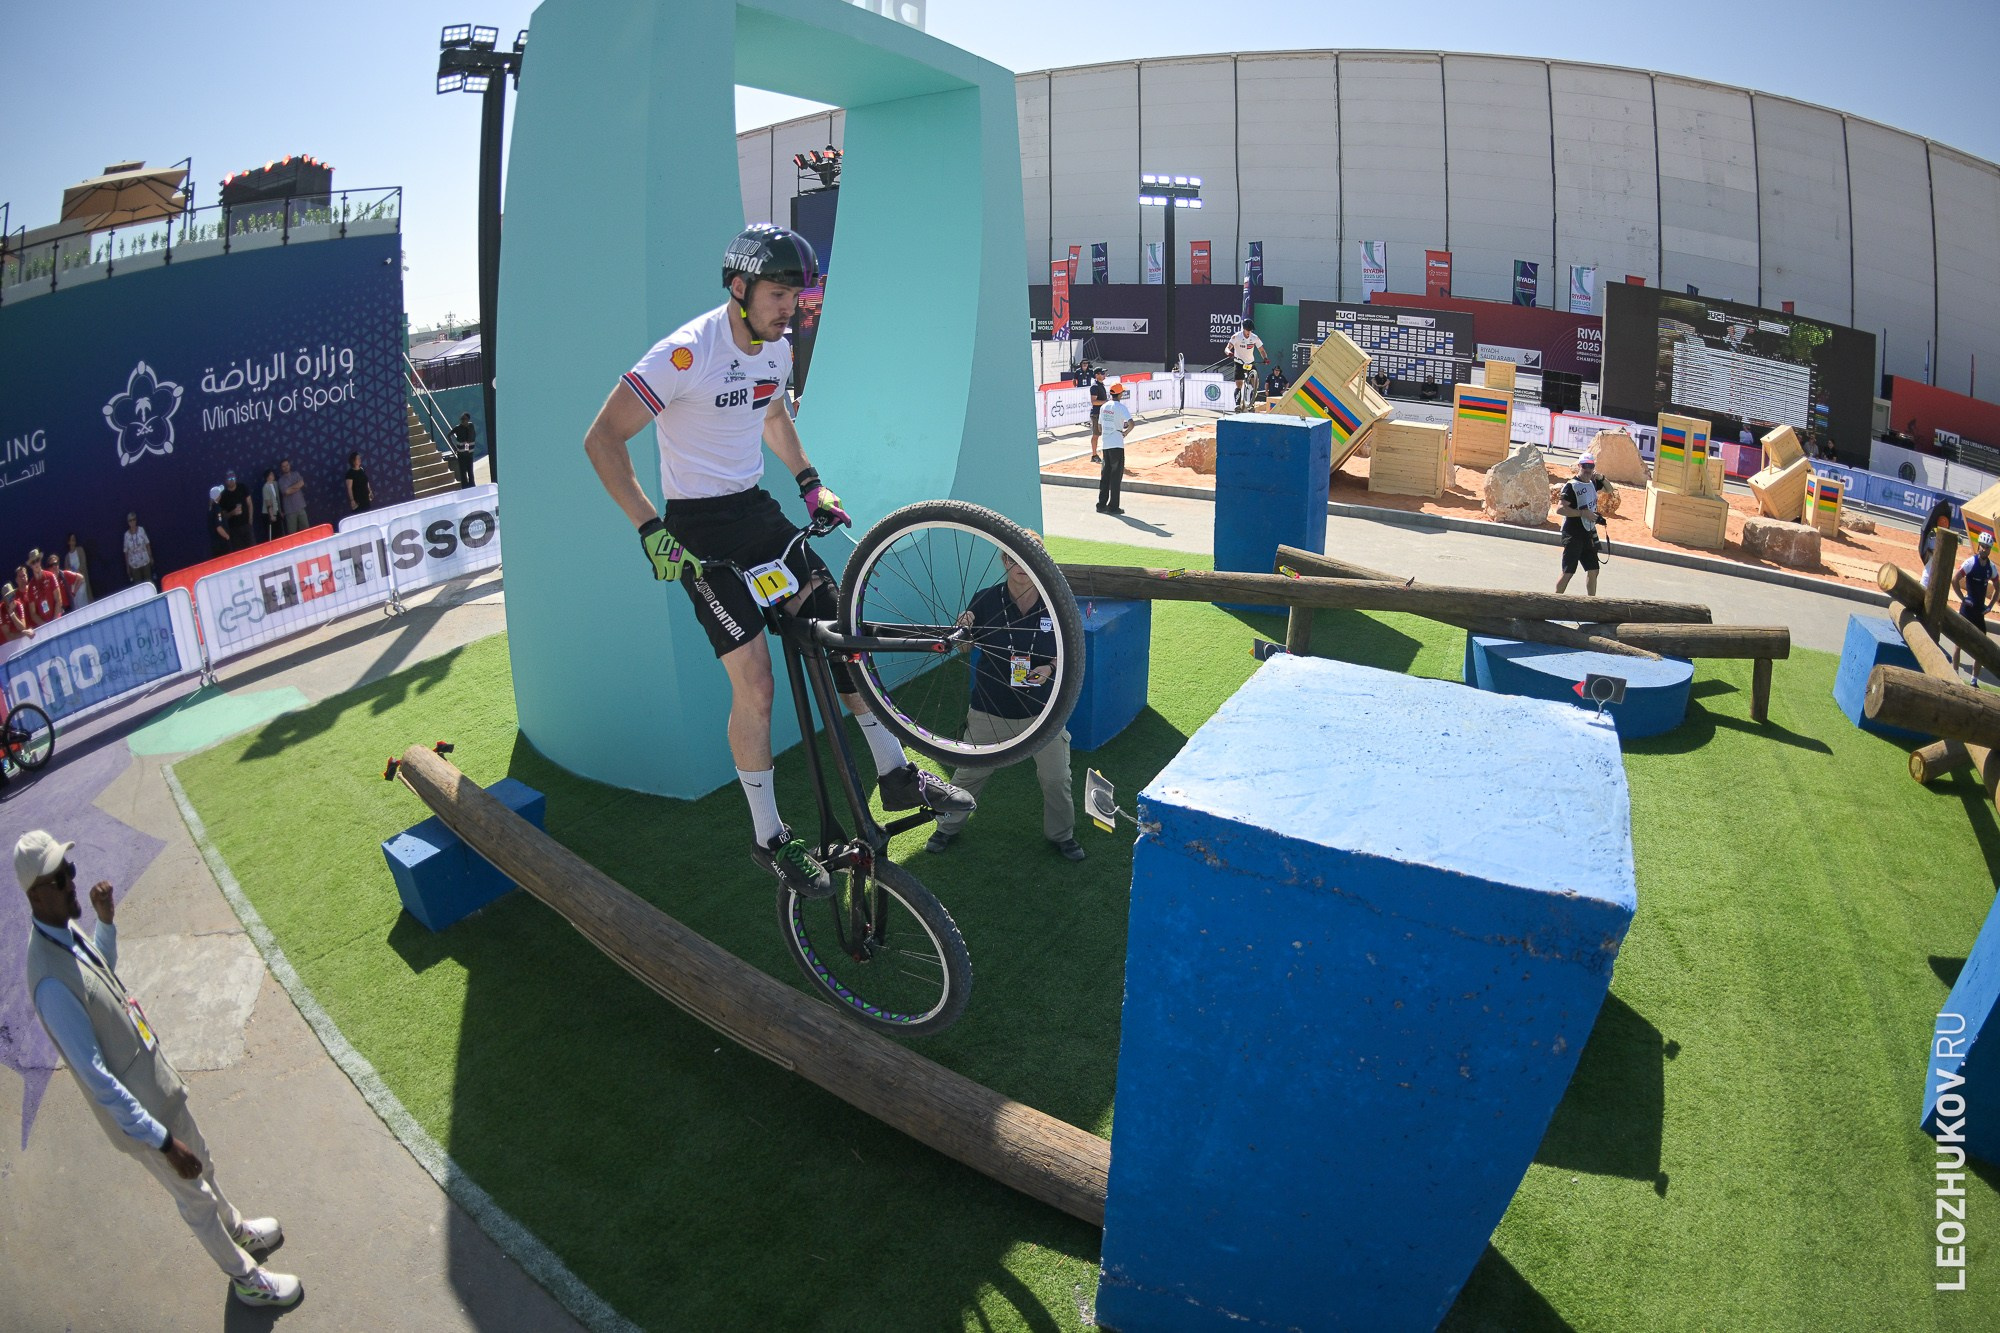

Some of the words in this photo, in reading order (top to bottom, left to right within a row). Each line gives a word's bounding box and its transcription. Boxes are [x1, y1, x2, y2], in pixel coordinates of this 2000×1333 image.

[723, 252, 764, 275] CONTROL
[1516, 275, 1536, 285] RIYADH
[1571, 293, 1591, 301] RIYADH
[1209, 314, 1241, 324] RIYAD
[1340, 312, 1355, 320] UCI
[1710, 312, 1725, 322] UCI
[1209, 326, 1232, 334] 2025
[1577, 327, 1602, 341] RIYA
[1576, 341, 1600, 352] 2025
[296, 344, 354, 381] وزارة
[201, 351, 286, 393] الرياضة
[715, 388, 749, 408] GBR
[1151, 389, 1162, 400] UCI
[202, 398, 273, 432] Ministry
[278, 389, 298, 413] of
[302, 378, 356, 412] Sport
[1983, 445, 2000, 455] CYCLING
[338, 504, 500, 586] TISSO
[317, 559, 374, 586] CYCLING
[767, 575, 779, 589] 1
[694, 576, 716, 602] MIND
[709, 600, 746, 641] CONTROL
